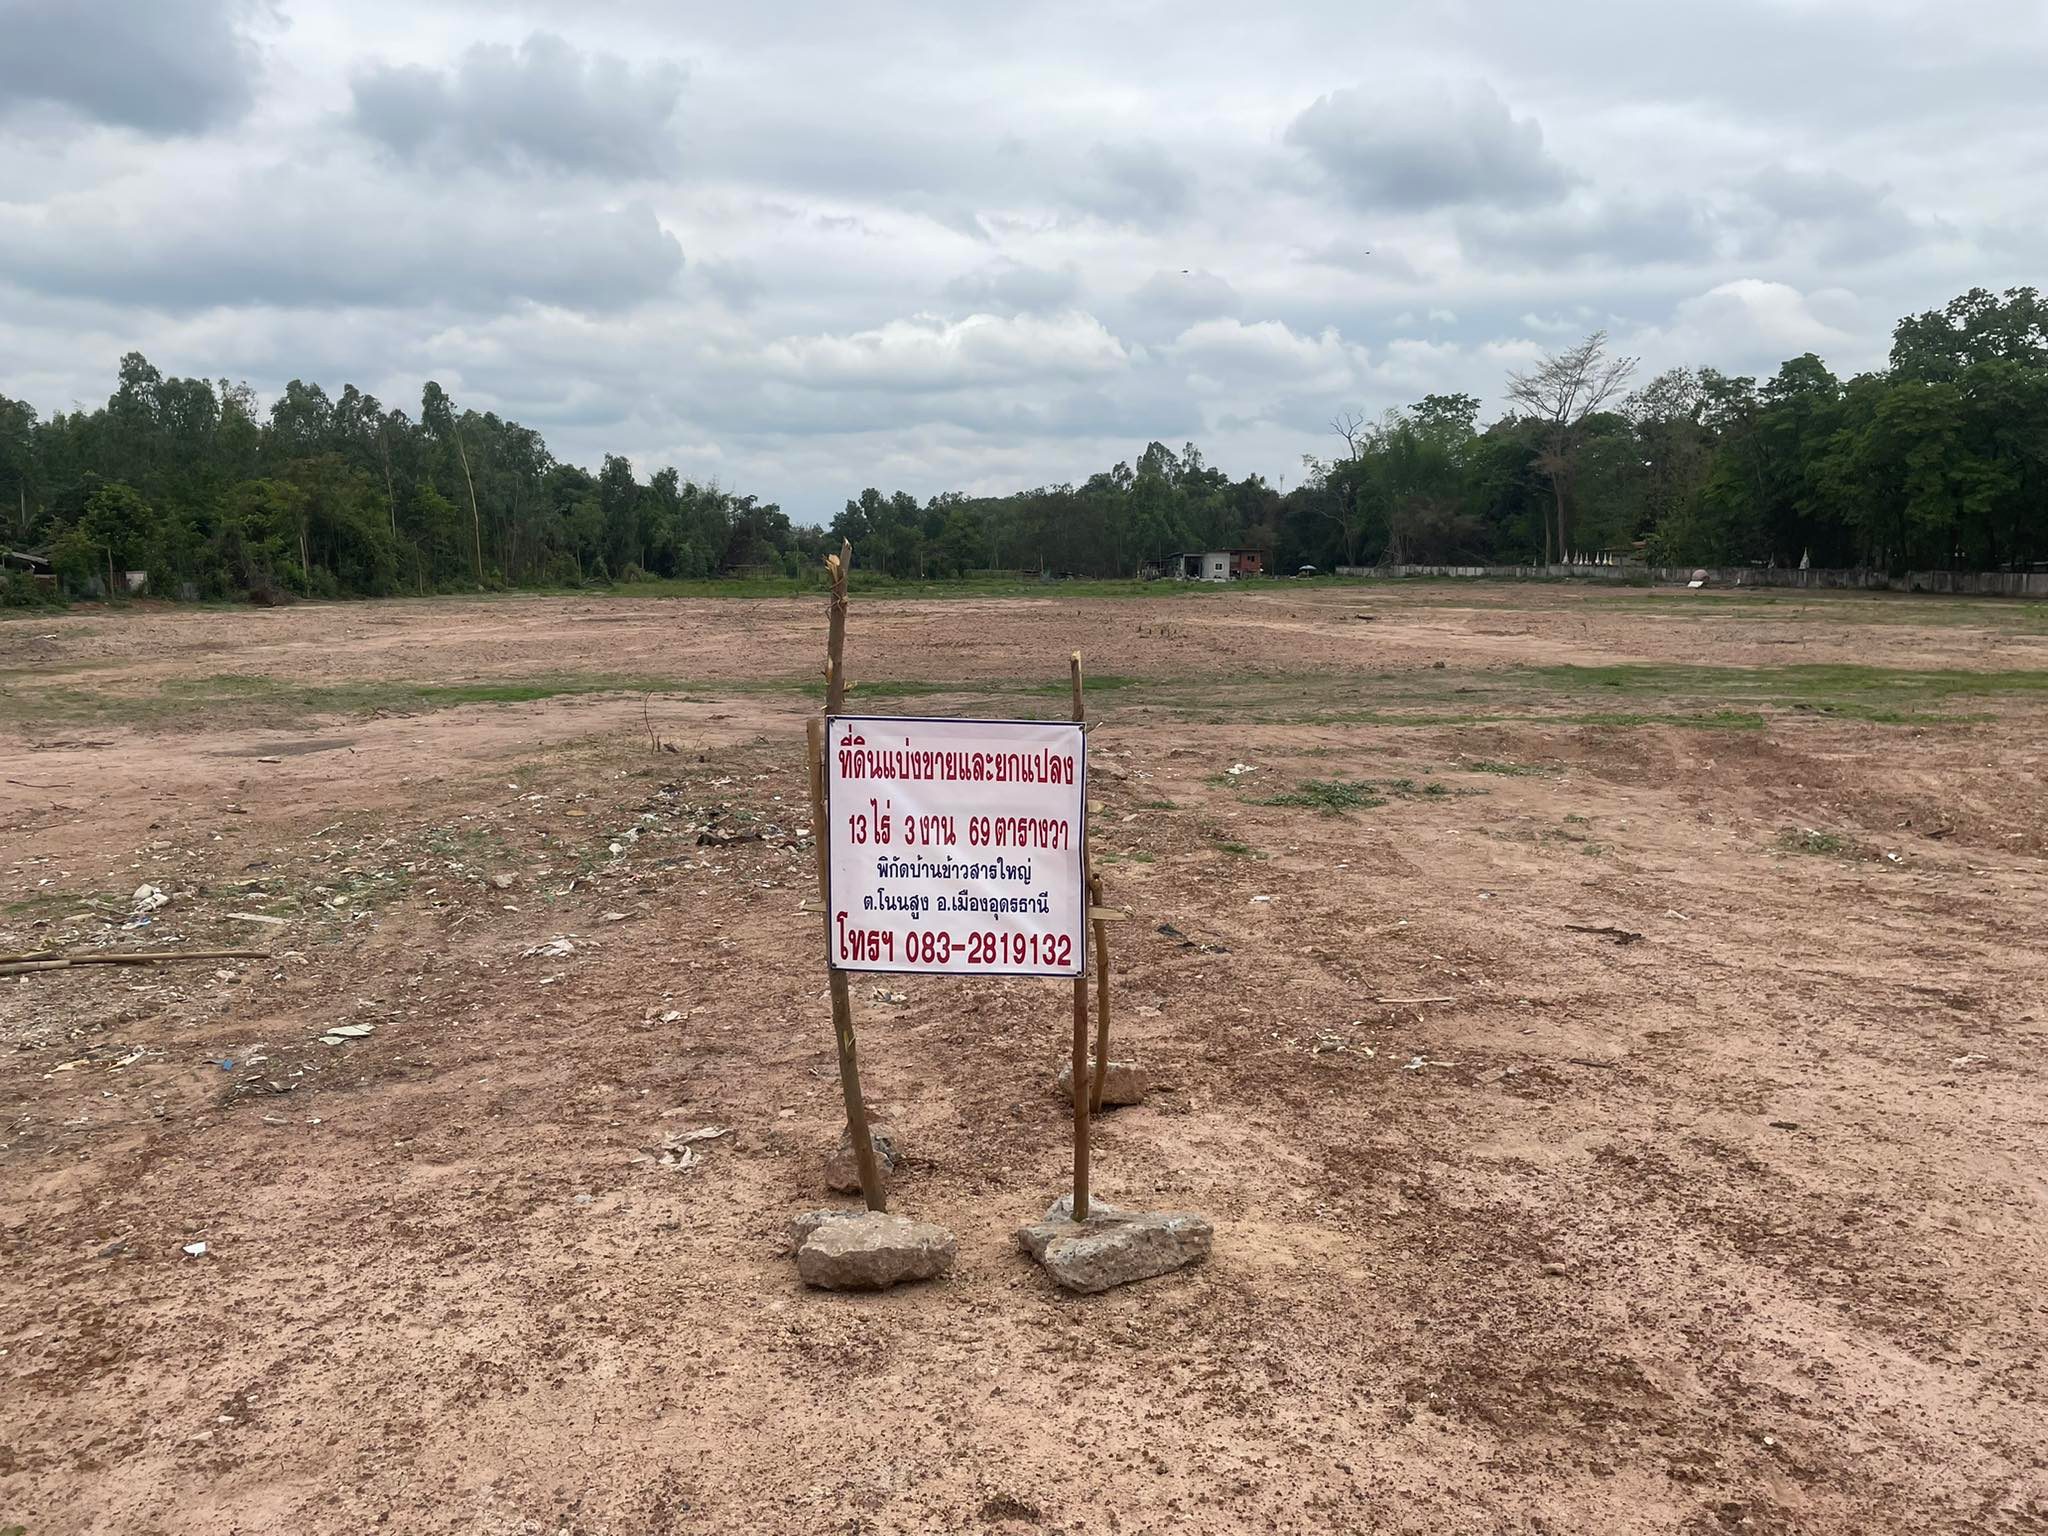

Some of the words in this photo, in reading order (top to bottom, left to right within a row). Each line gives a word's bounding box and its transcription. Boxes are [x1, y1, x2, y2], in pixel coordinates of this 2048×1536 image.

[838, 724, 1074, 785] ที่ดินแบ่งขายและยกแปลง
[877, 855, 1032, 885] พิกัดบ้านข้าวสารใหญ่
[863, 888, 929, 920] ต.โนนสูง
[937, 889, 1049, 920] อ.เมืองอุดรธานี
[837, 912, 893, 962] โทรฯ
[905, 931, 1072, 966] 083-2819132
